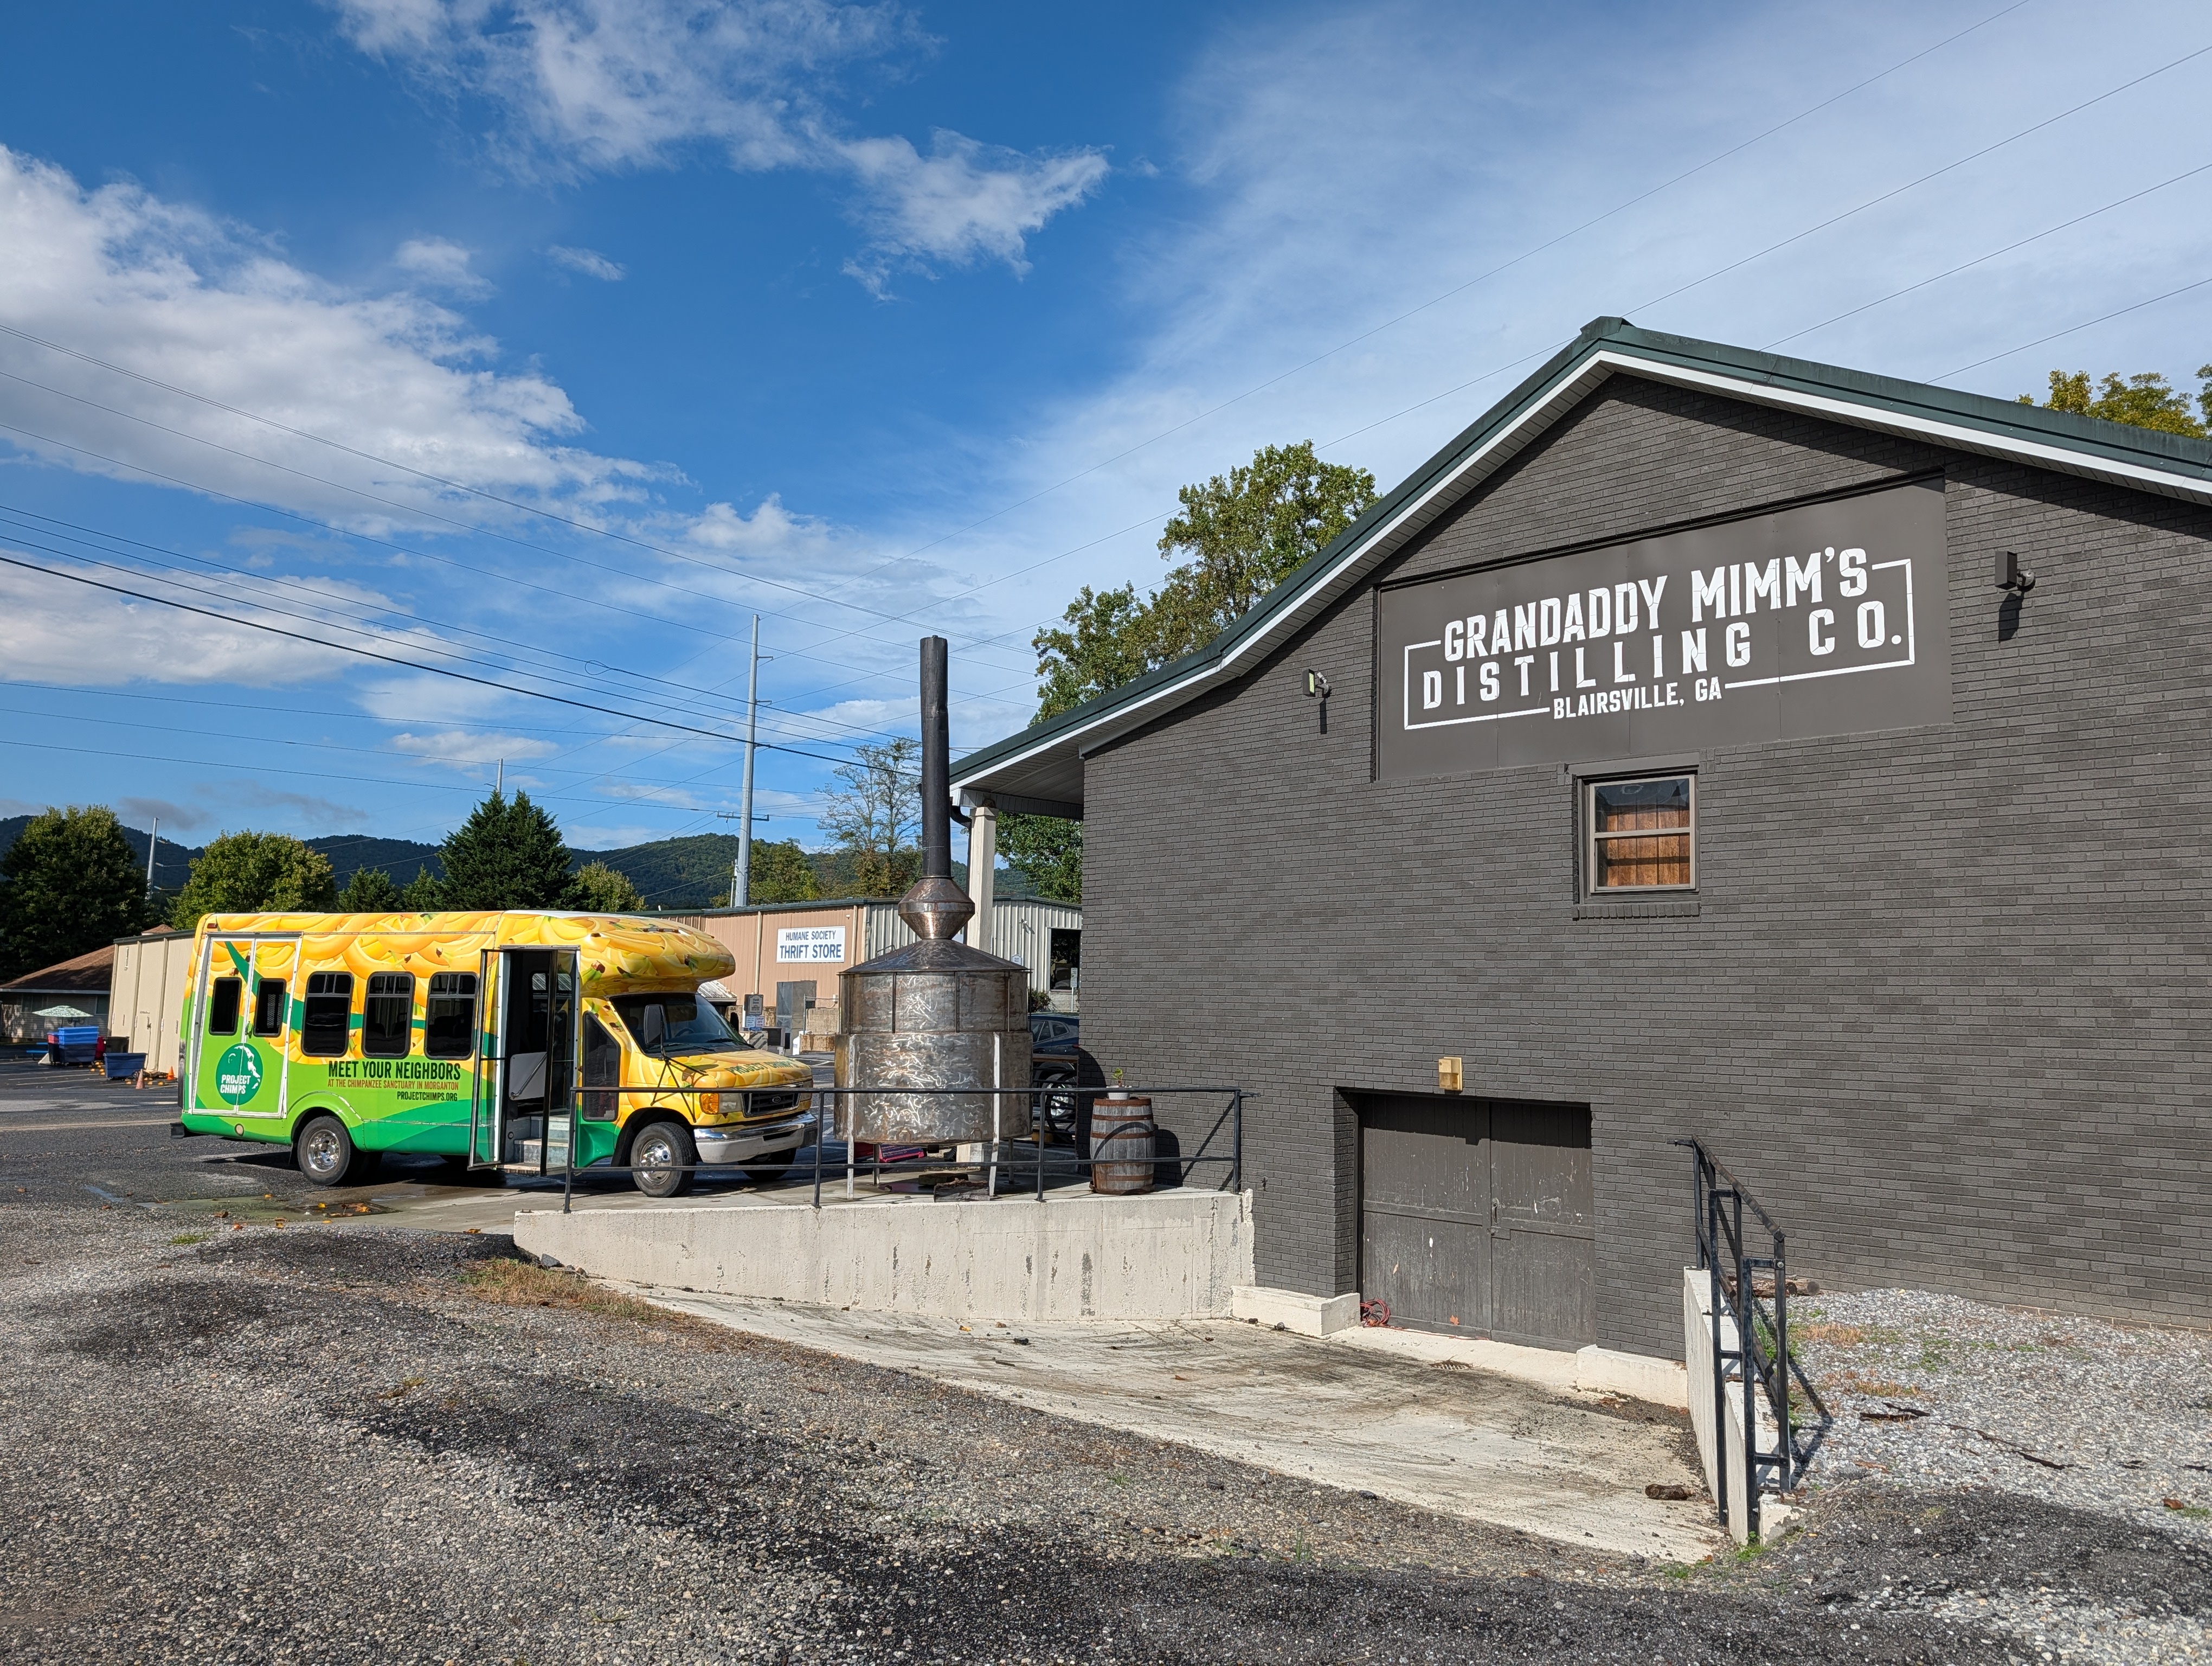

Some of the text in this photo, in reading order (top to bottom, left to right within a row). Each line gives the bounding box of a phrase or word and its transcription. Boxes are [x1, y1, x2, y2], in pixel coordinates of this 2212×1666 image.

[1444, 547, 1867, 662] GRANDADDY MIMM'S
[1423, 600, 1902, 710] DISTILLING CO.
[1553, 676, 1722, 720] BLAIRSVILLE, GA
[786, 930, 836, 941] HUMANE SOCIETY
[780, 944, 842, 959] THRIFT STORE
[329, 1061, 461, 1080] MEET YOUR NEIGHBORS
[724, 1062, 768, 1075] PROJECT
[221, 1074, 251, 1085] PROJECT
[327, 1079, 459, 1090] AT THE CHIMPANZEE SANCTUARY IN MORGANTON
[220, 1084, 246, 1094] CHIMPS
[397, 1091, 458, 1101] PROJECTCHIMPS.ORG
